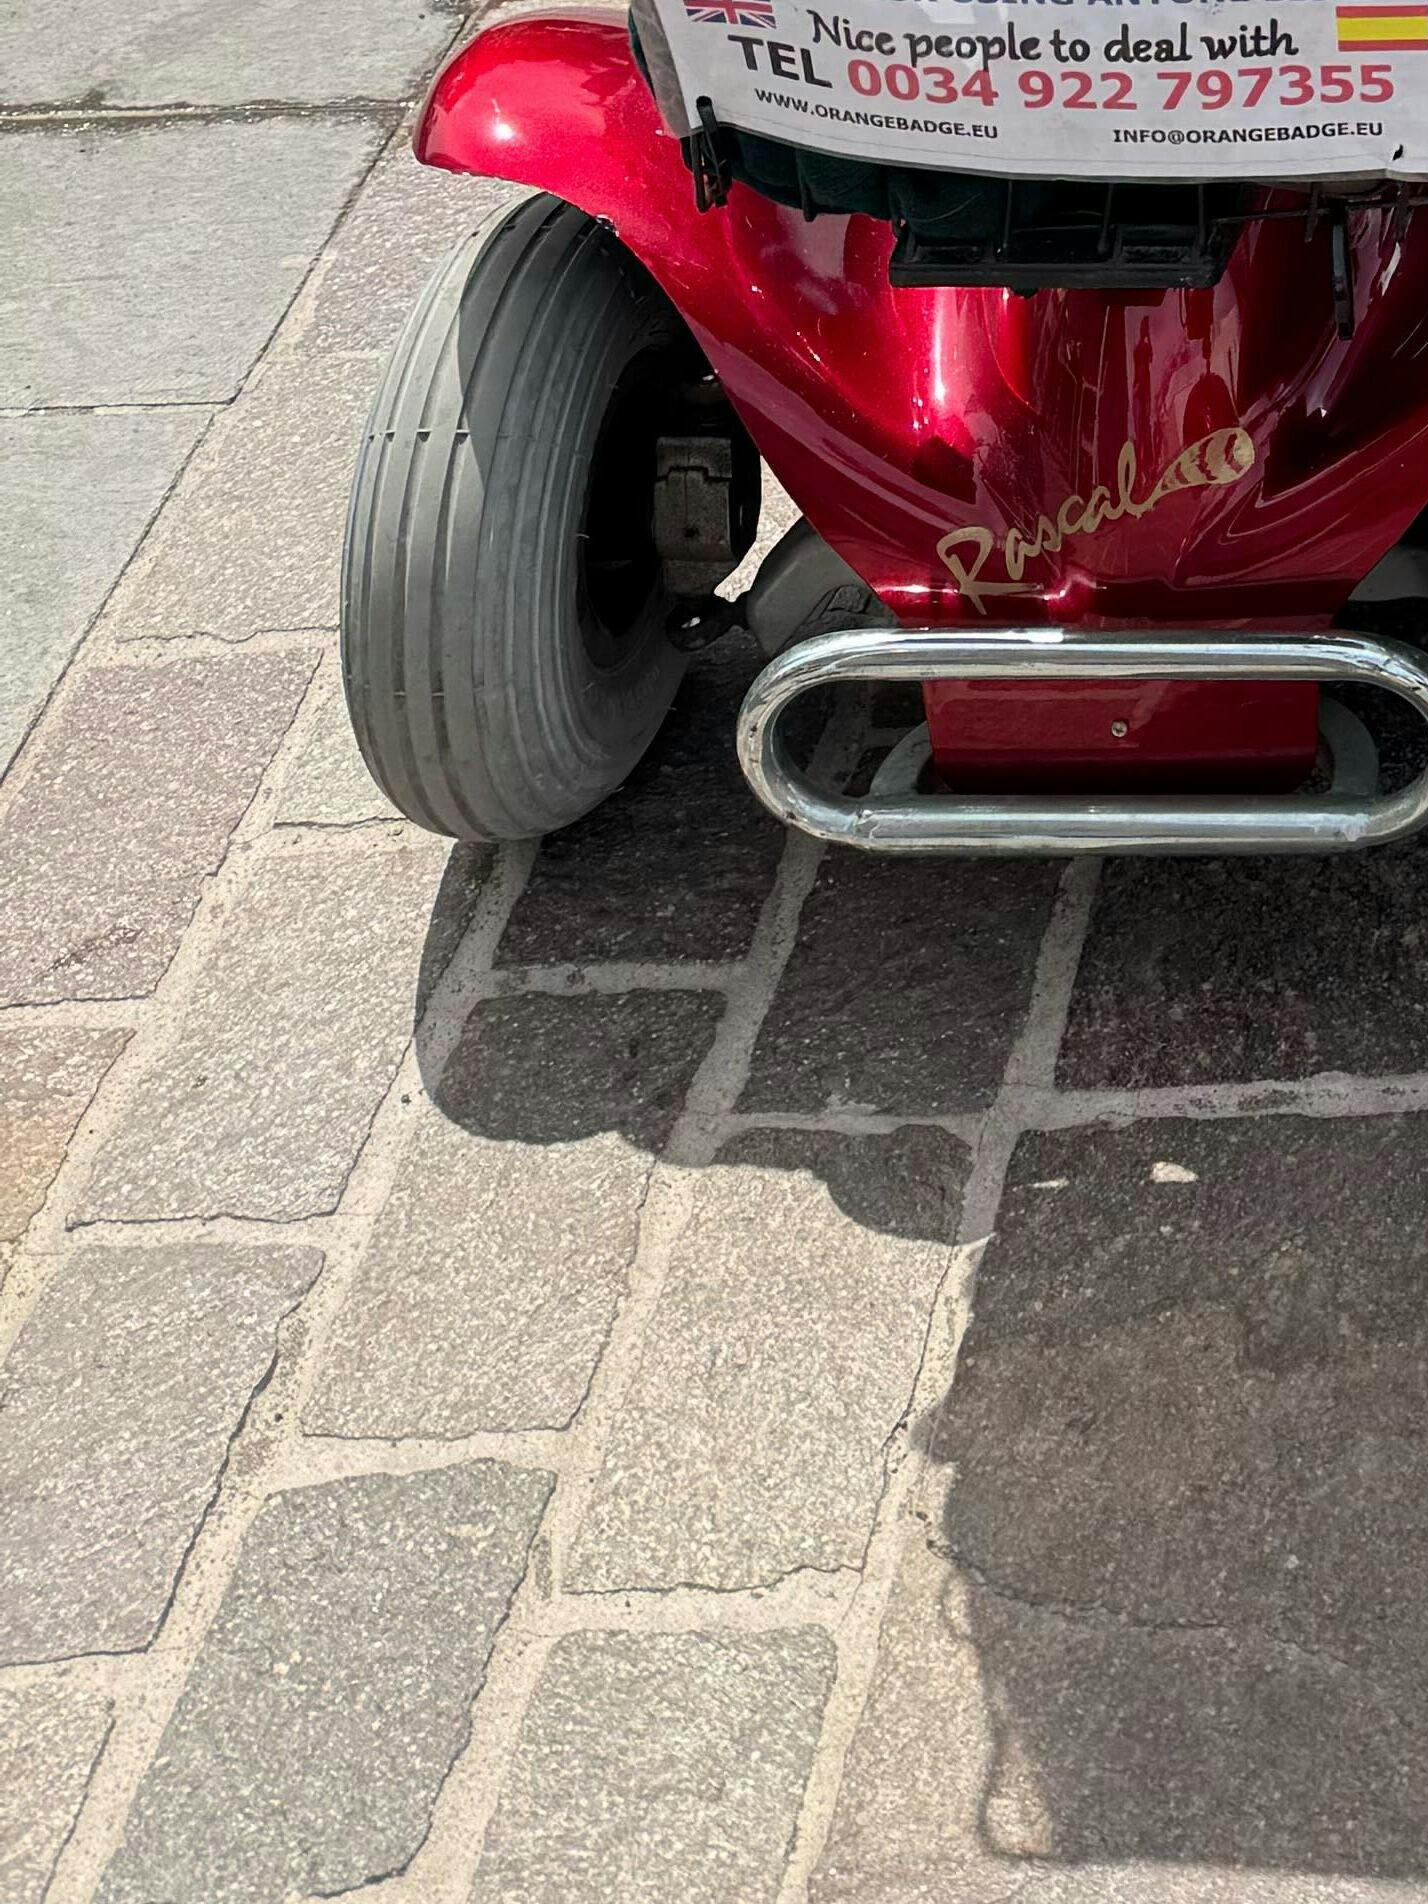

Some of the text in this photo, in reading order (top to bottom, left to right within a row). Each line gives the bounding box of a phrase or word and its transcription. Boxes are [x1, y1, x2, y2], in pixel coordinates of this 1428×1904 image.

[727, 34, 1394, 111] TEL 0034 922 797355
[806, 9, 1299, 73] Nice people to deal with
[755, 88, 1384, 144] WWW.ORANGEBADGE.EU INFO@ORANGEBADGE.EU
[936, 440, 1153, 615] Rascal
